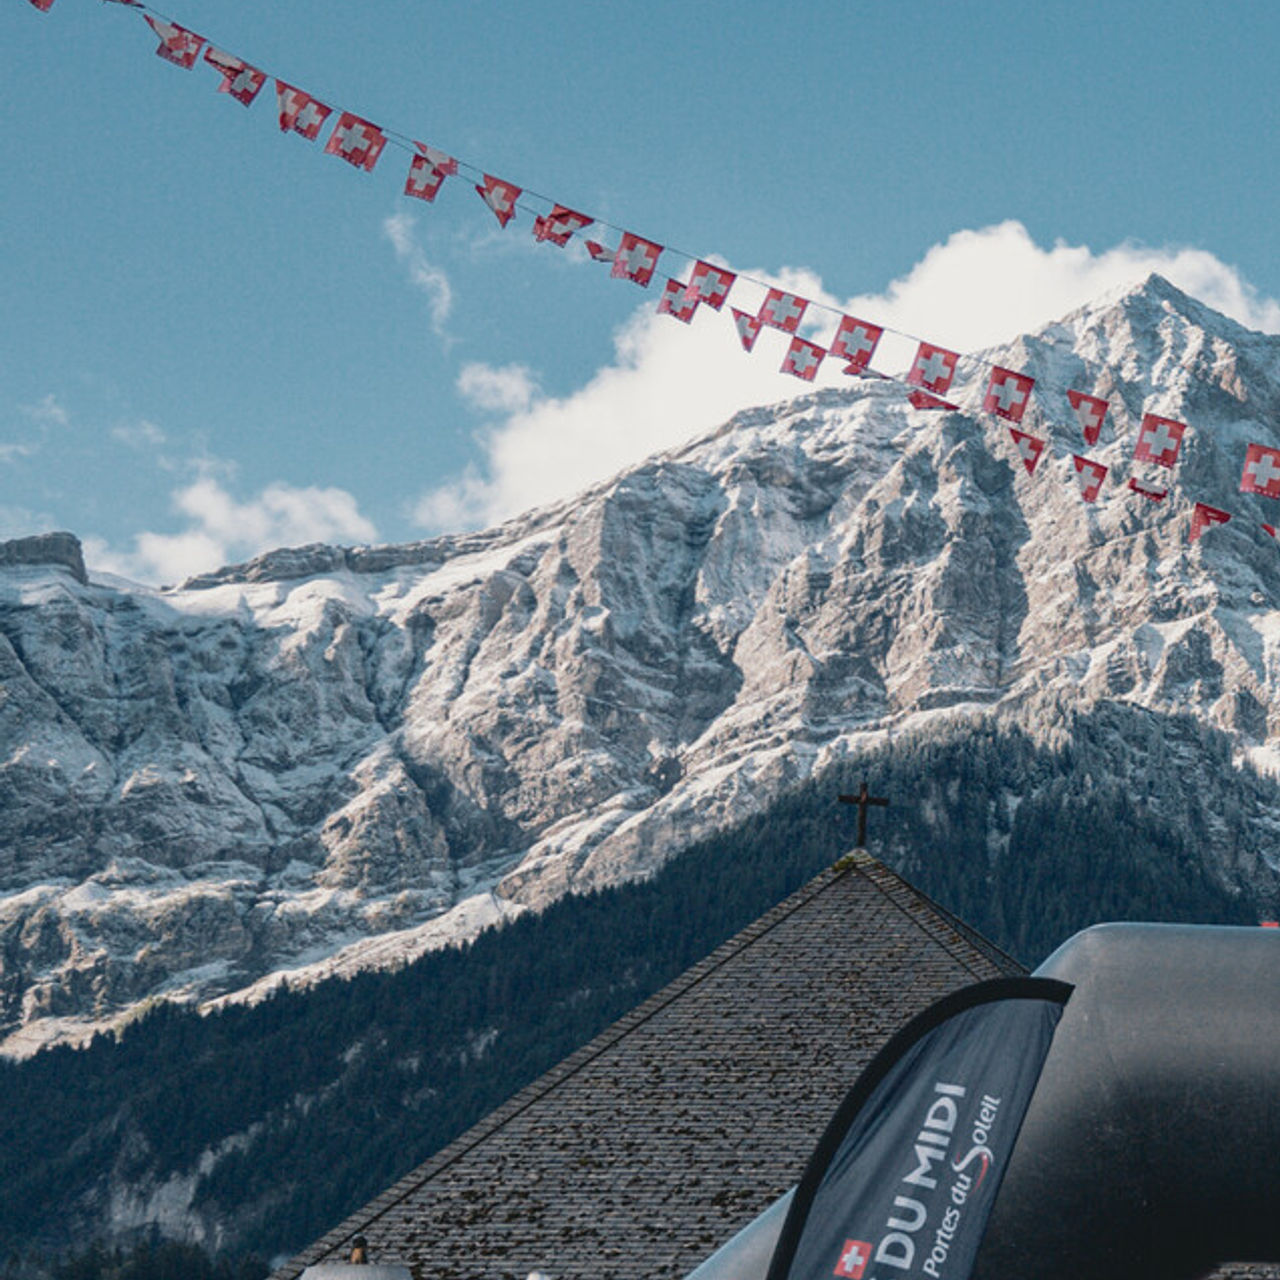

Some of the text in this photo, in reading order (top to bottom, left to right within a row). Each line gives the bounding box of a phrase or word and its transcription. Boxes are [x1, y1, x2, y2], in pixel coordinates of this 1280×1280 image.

[874, 1194, 928, 1271] DU
[902, 1081, 966, 1191] MIDI
[923, 1094, 1002, 1279] Portes du Soleil
